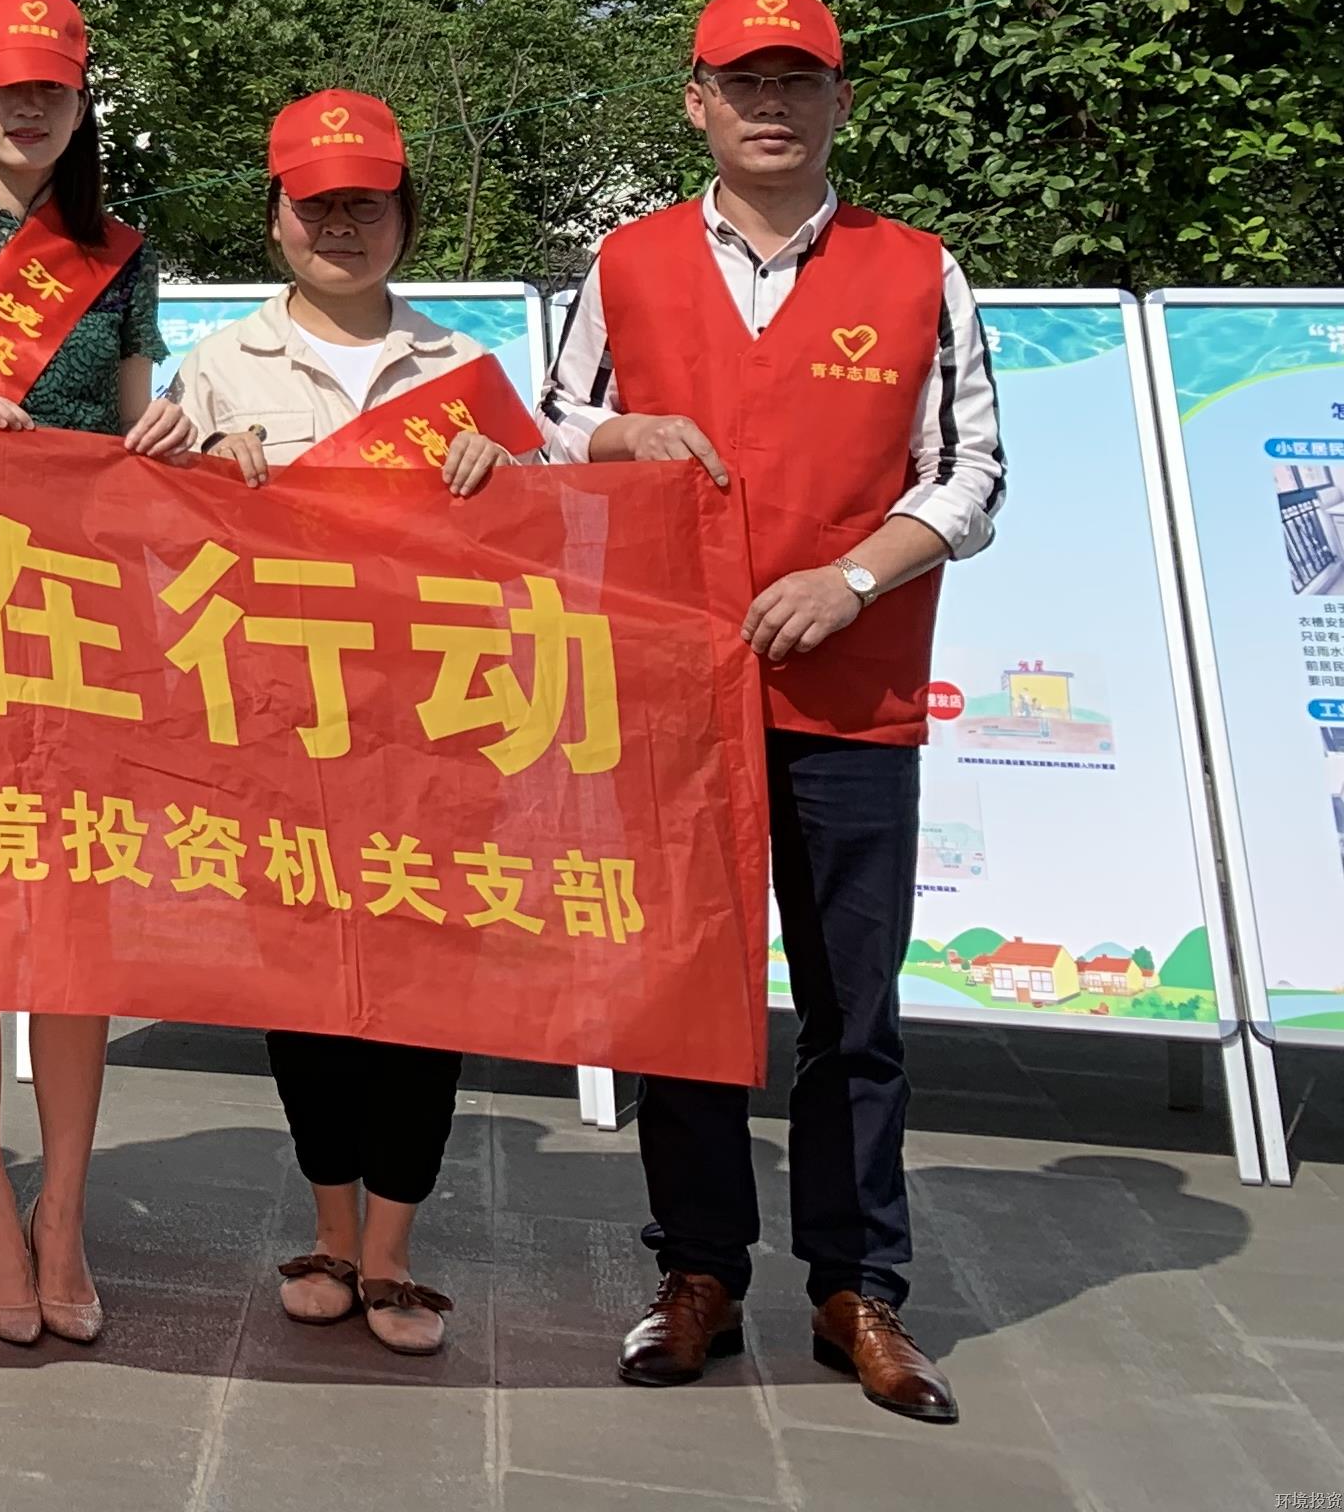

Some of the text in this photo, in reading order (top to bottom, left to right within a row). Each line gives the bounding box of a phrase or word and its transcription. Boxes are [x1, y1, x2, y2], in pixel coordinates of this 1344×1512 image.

[810, 362, 900, 385] 青年志愿者
